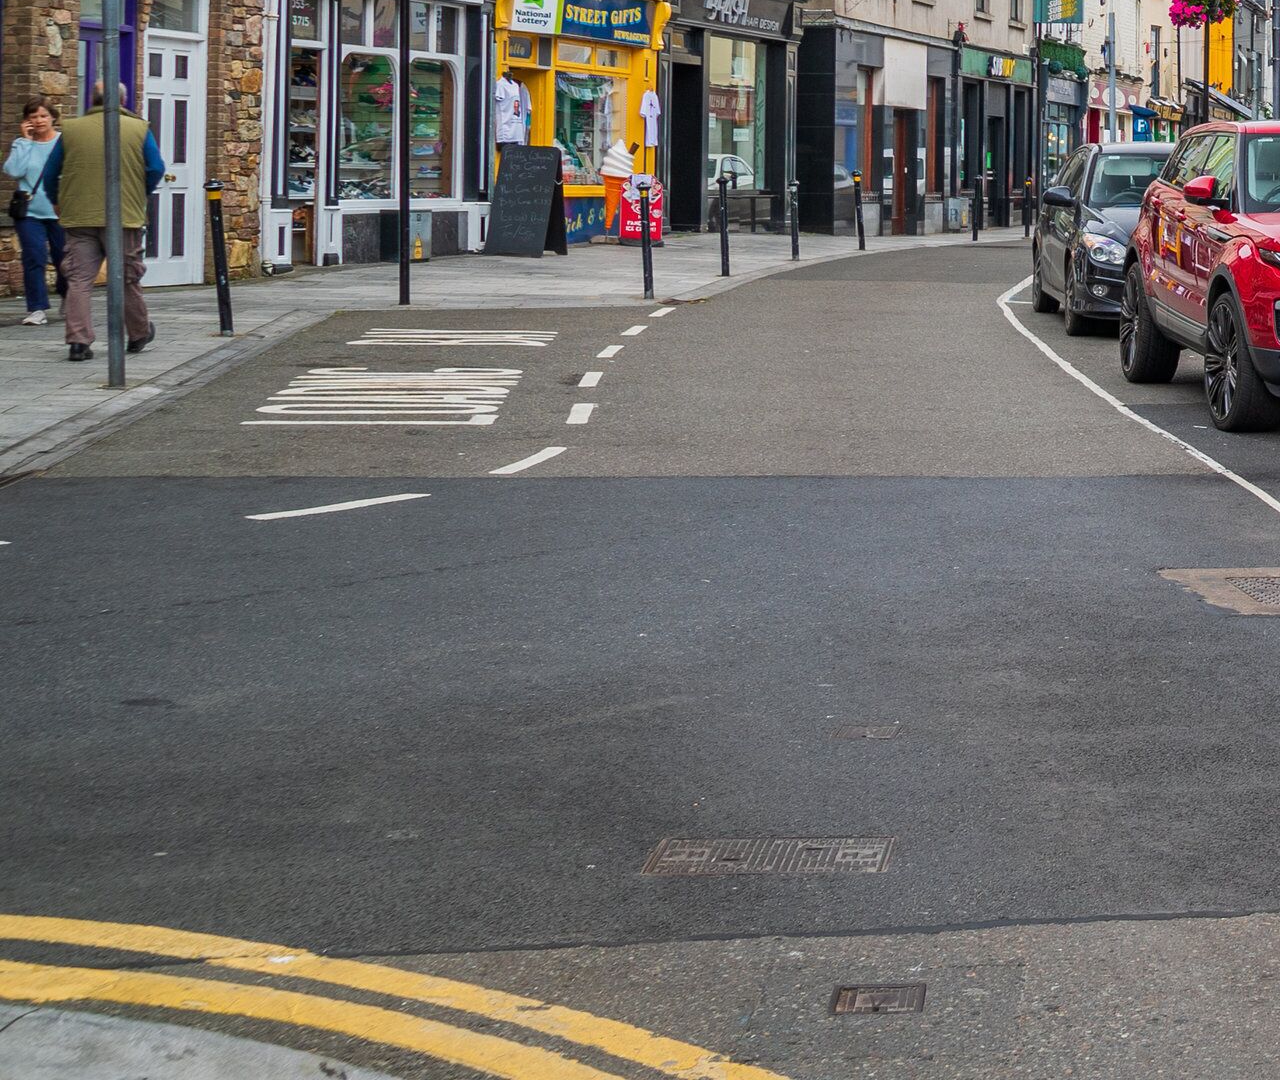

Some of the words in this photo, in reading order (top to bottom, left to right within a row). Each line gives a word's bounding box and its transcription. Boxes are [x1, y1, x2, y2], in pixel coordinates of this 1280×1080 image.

[515, 9, 551, 19] National
[565, 4, 608, 26] STREET
[611, 7, 641, 27] GIFTS
[517, 16, 548, 27] Lottery
